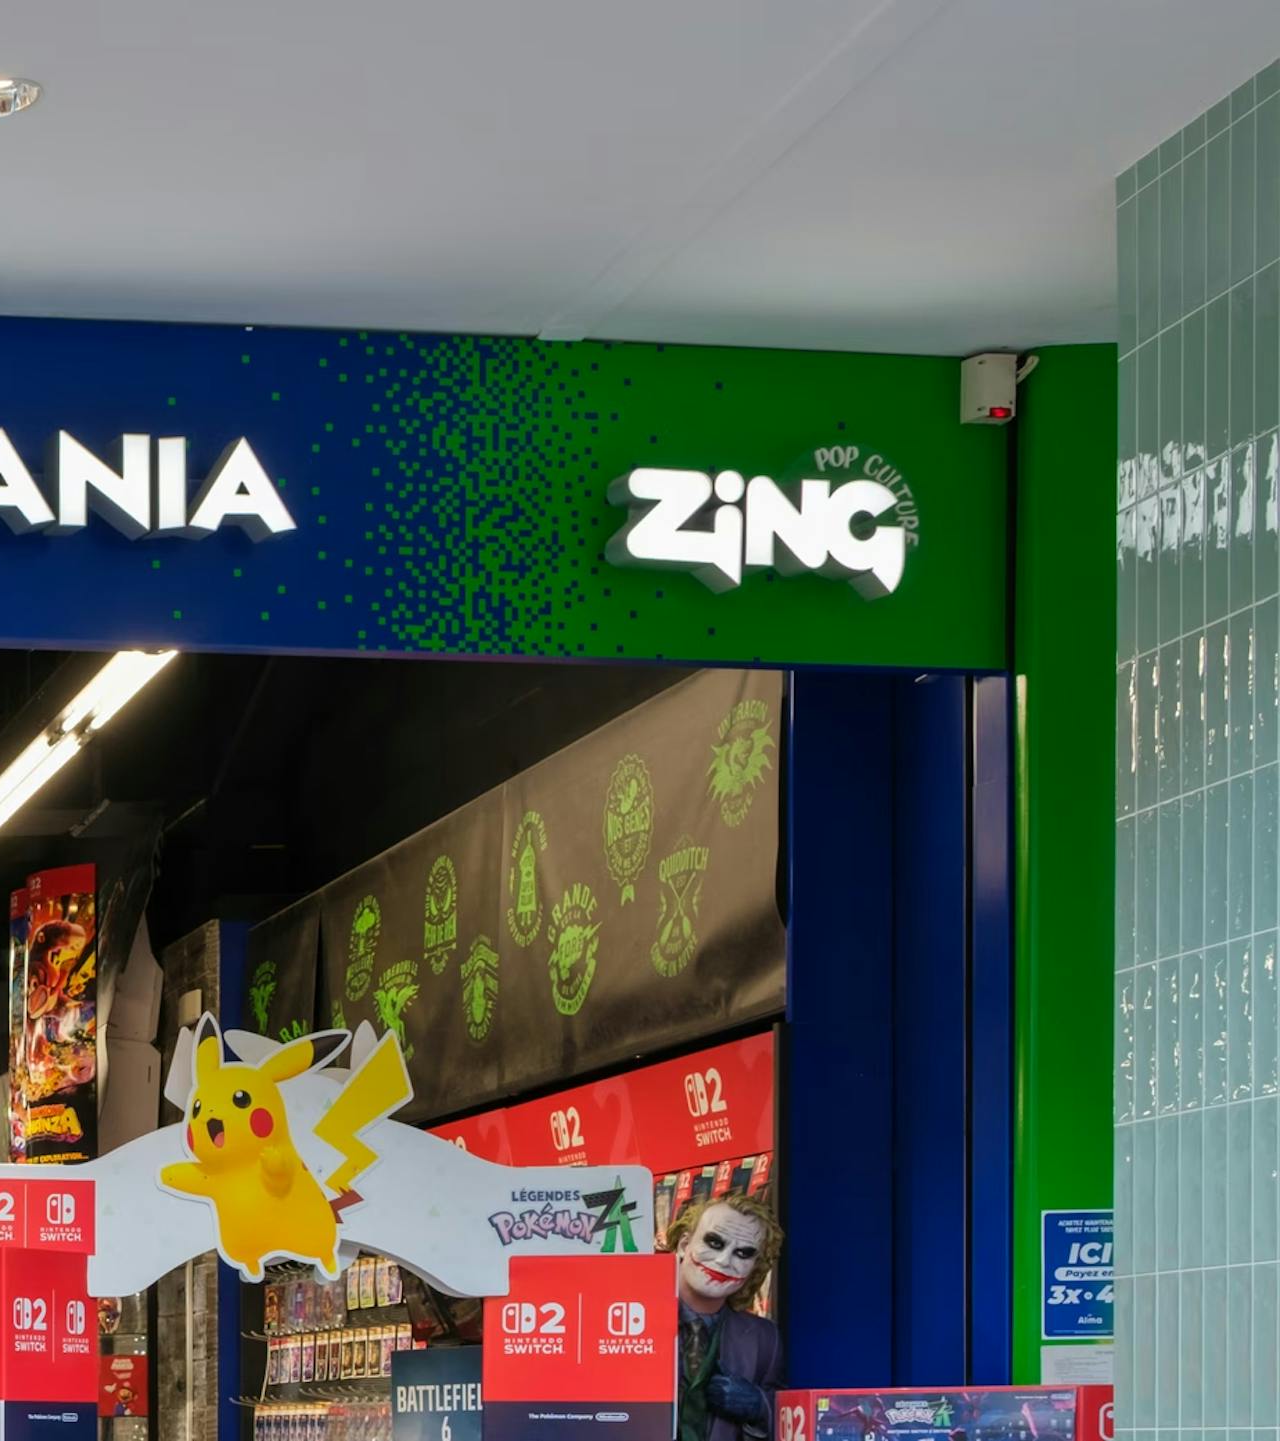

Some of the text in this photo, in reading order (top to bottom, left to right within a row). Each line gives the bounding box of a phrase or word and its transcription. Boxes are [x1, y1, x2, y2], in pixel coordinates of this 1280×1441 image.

[814, 446, 920, 547] POP CULTURE
[547, 882, 598, 943] GRANDE
[695, 1127, 732, 1148] SWITCH
[512, 1188, 580, 1202] LÉGENDES
[40, 1233, 81, 1241] SWITCH
[1068, 1242, 1113, 1265] ICI
[1065, 1270, 1099, 1279] Payez
[1047, 1285, 1083, 1305] 3x
[33, 1298, 47, 1331] 2
[540, 1302, 565, 1334] 2
[1078, 1314, 1103, 1325] Alma
[15, 1341, 46, 1352] SWITCH
[63, 1344, 89, 1353] SWITCH
[504, 1344, 563, 1354] SWITCH
[599, 1344, 653, 1354] SWITCH
